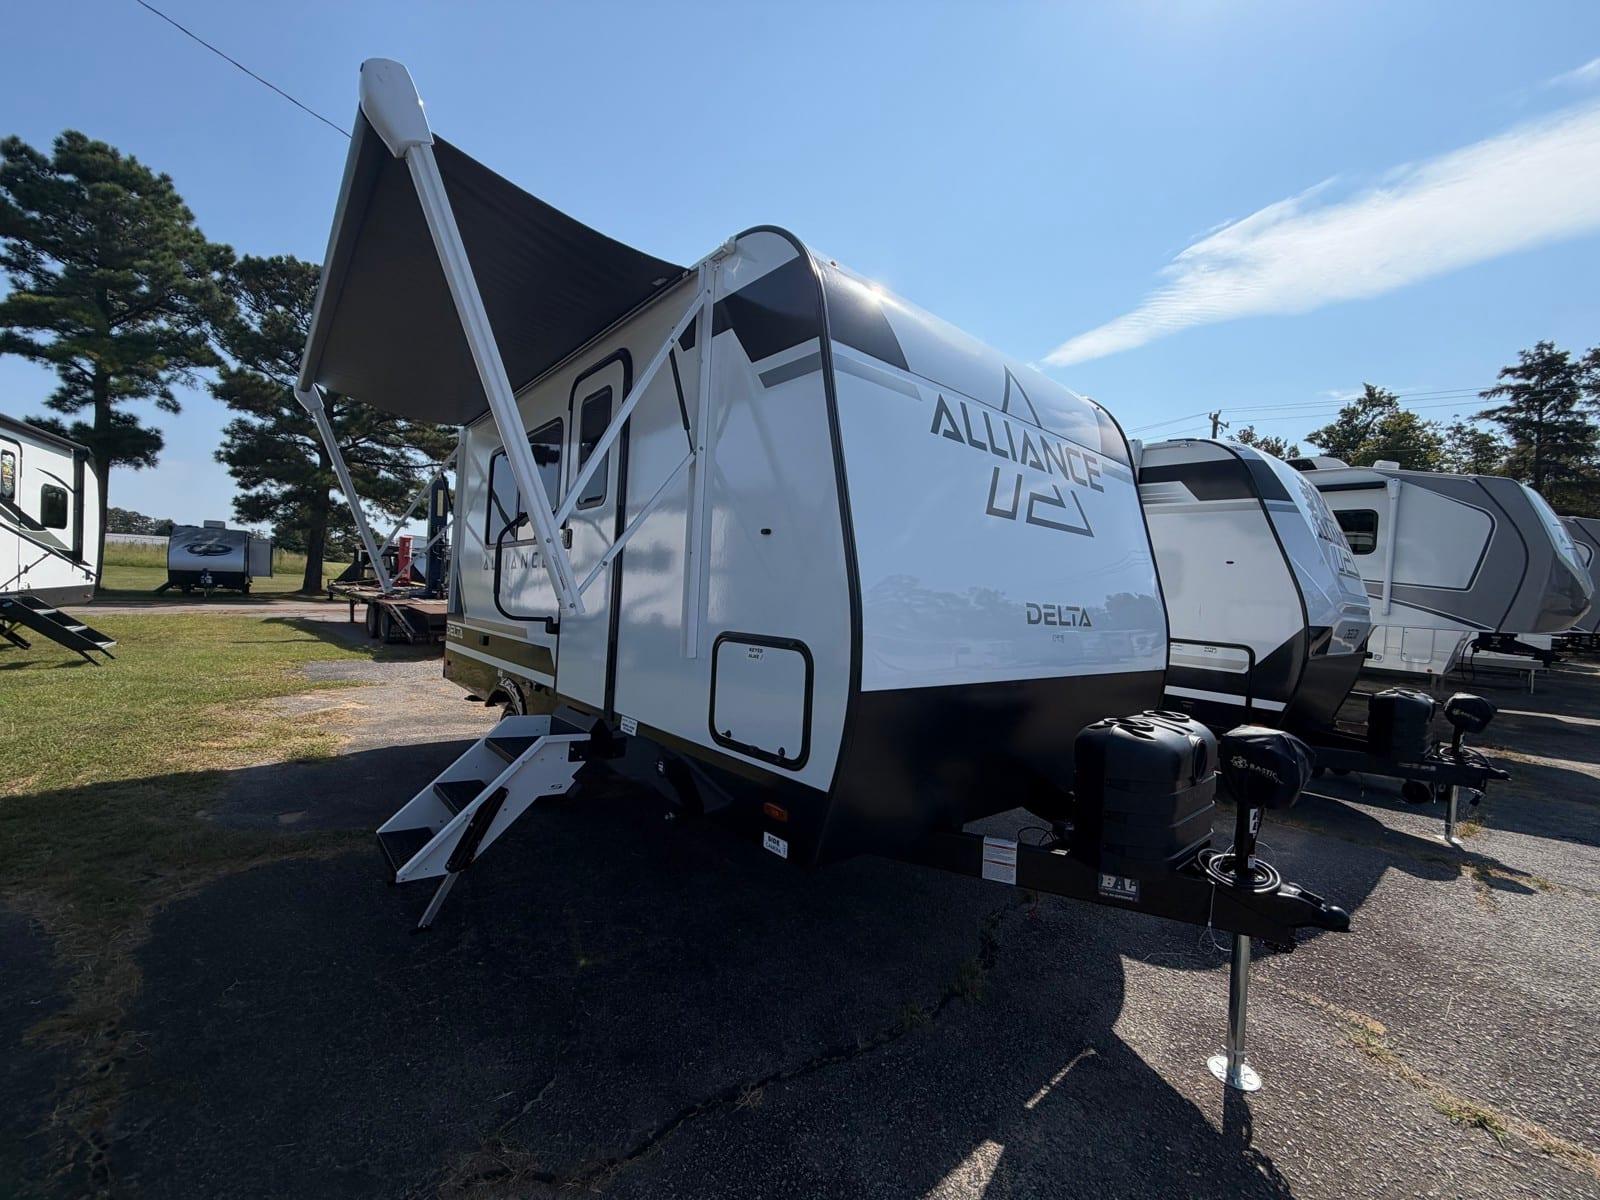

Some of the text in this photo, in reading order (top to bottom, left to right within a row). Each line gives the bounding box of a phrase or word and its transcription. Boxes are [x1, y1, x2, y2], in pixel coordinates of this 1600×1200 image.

[930, 393, 1105, 493] ALLIANCE
[483, 551, 547, 570] ALIANCE
[1025, 602, 1092, 627] DELTA
[1101, 873, 1137, 893] BAL
